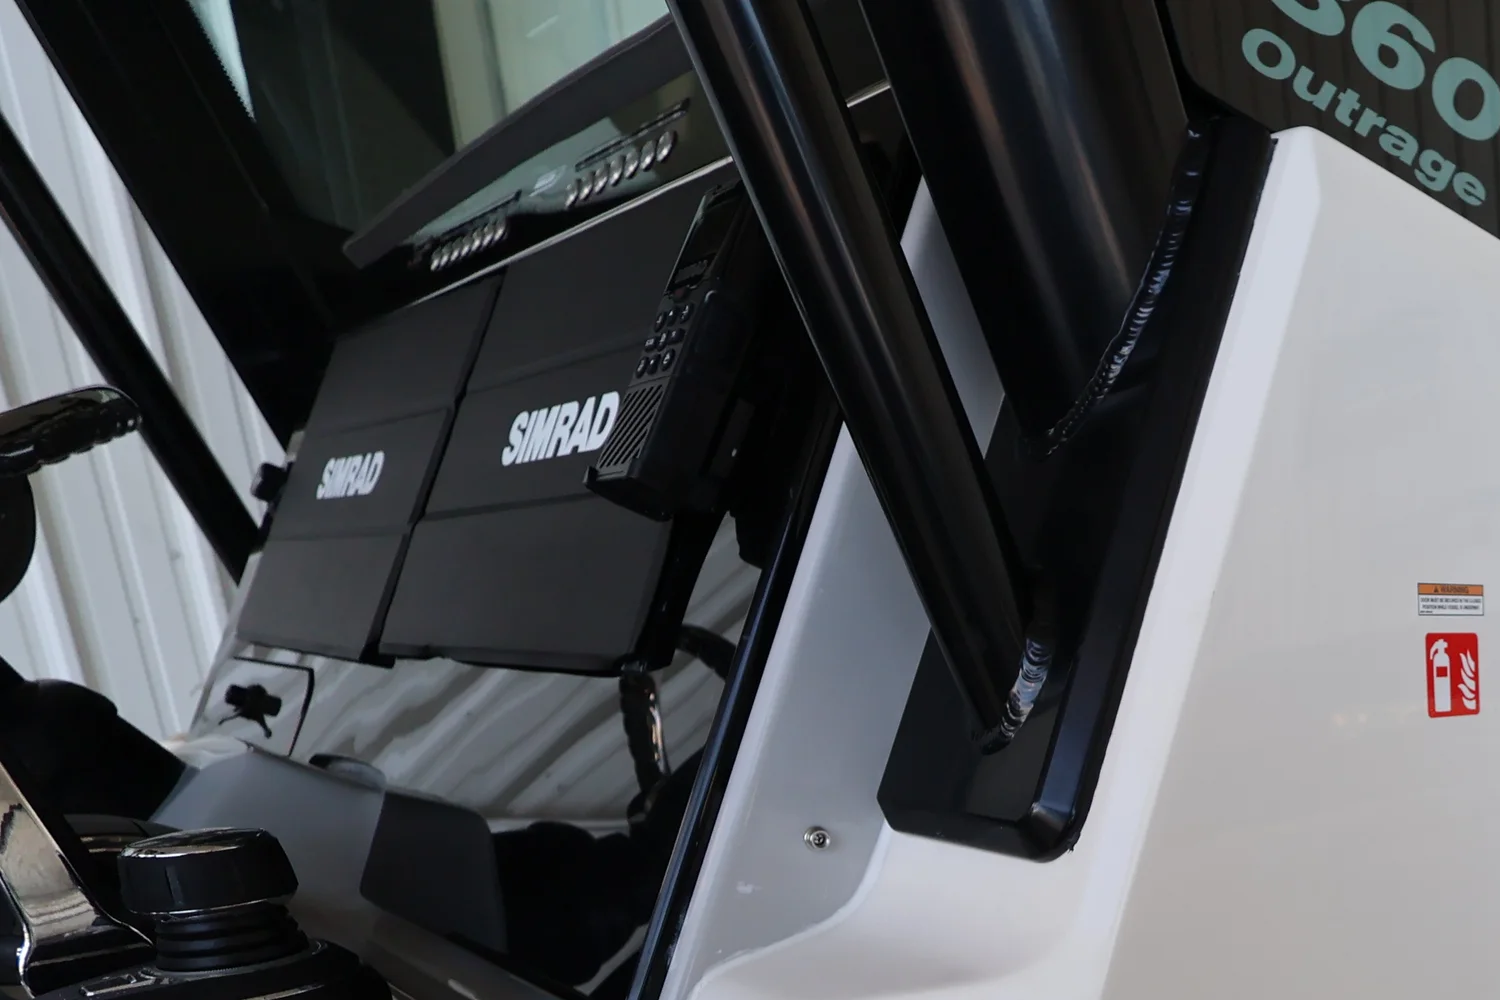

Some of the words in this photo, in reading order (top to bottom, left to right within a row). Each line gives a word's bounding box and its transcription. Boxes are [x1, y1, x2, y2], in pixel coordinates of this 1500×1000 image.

[1241, 28, 1487, 207] Outrage
[501, 390, 620, 467] SIMRAD
[316, 450, 385, 500] SIMRAD
